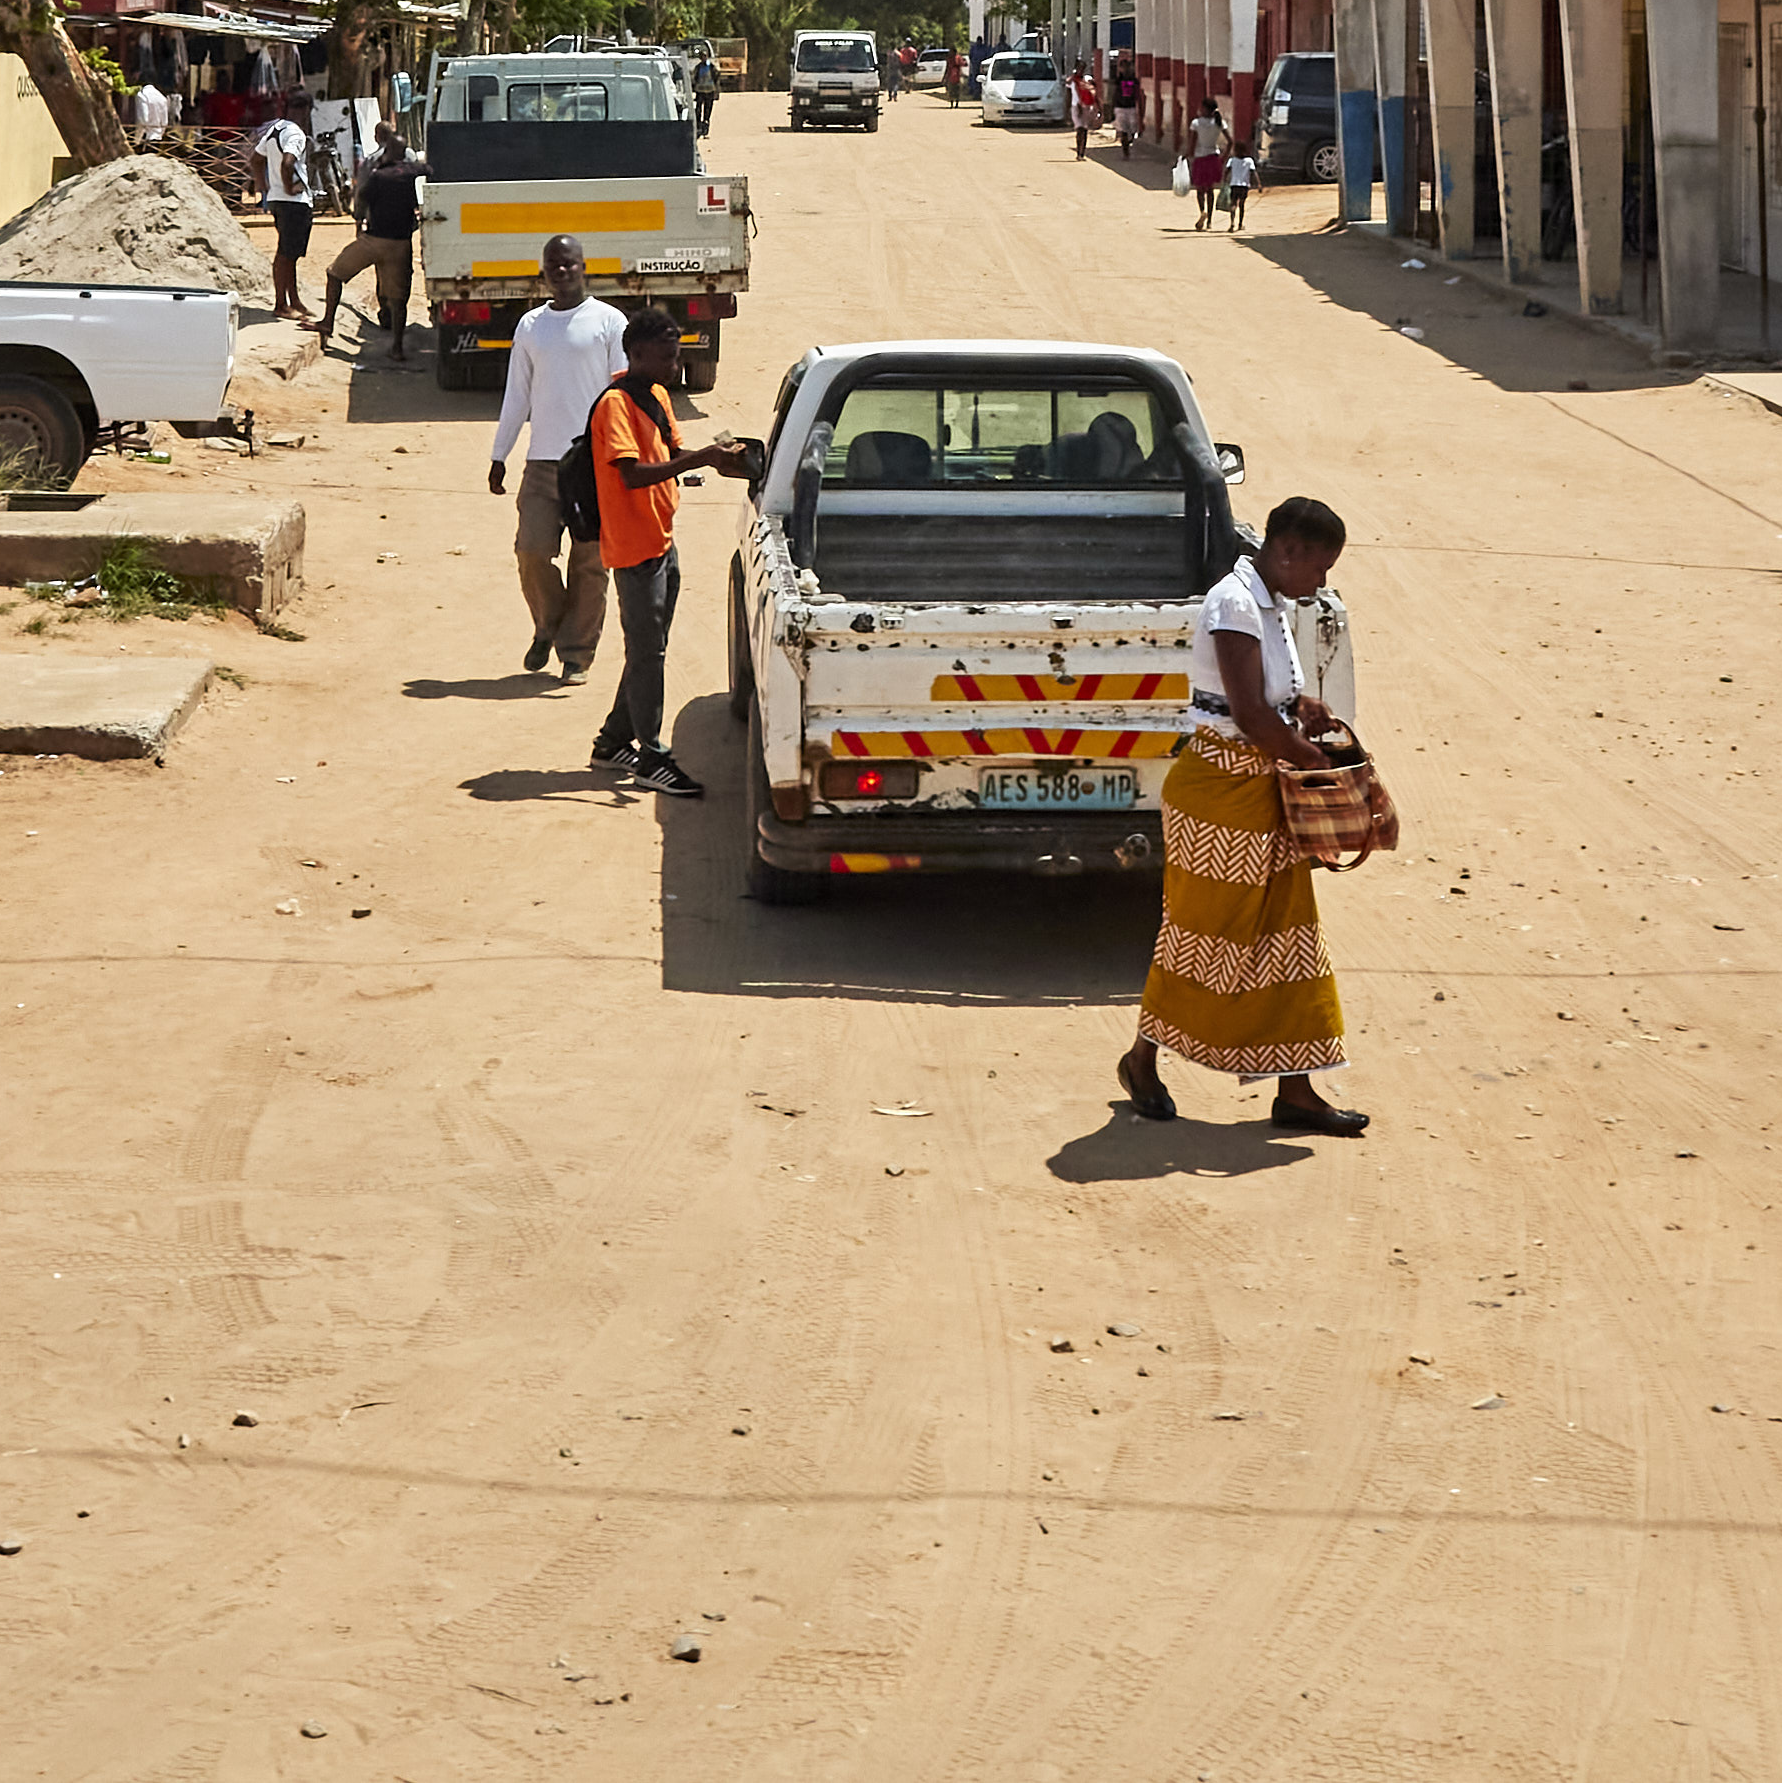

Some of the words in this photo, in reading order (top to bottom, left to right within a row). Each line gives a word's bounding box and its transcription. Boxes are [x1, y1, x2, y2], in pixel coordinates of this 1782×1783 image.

[707, 186, 726, 206] L
[673, 249, 713, 257] HINO
[640, 259, 701, 271] INSTRUÇÃO
[984, 774, 1029, 802] AES
[1037, 774, 1081, 802] 588
[1102, 774, 1132, 802] MP
